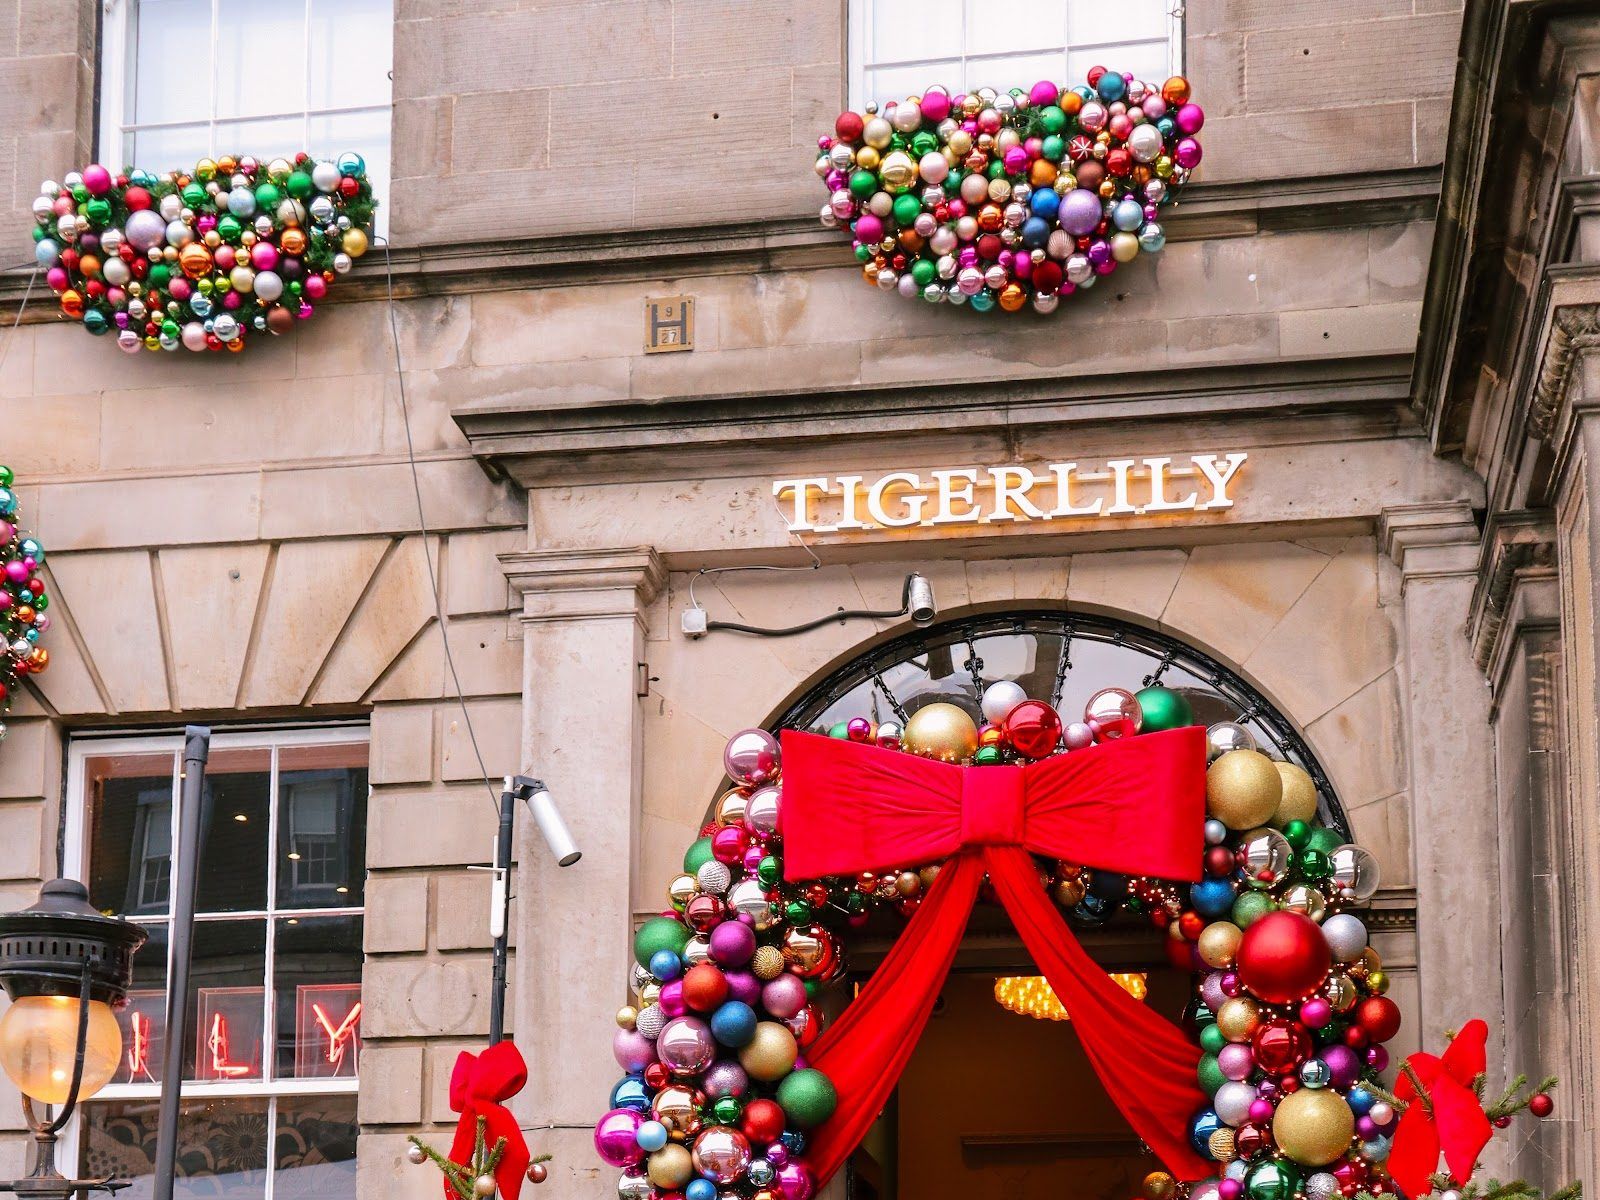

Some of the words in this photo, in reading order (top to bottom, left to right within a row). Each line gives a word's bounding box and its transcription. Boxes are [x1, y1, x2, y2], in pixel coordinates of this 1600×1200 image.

[651, 302, 687, 347] H
[665, 306, 673, 317] 9
[772, 453, 1248, 532] TIGERLILY
